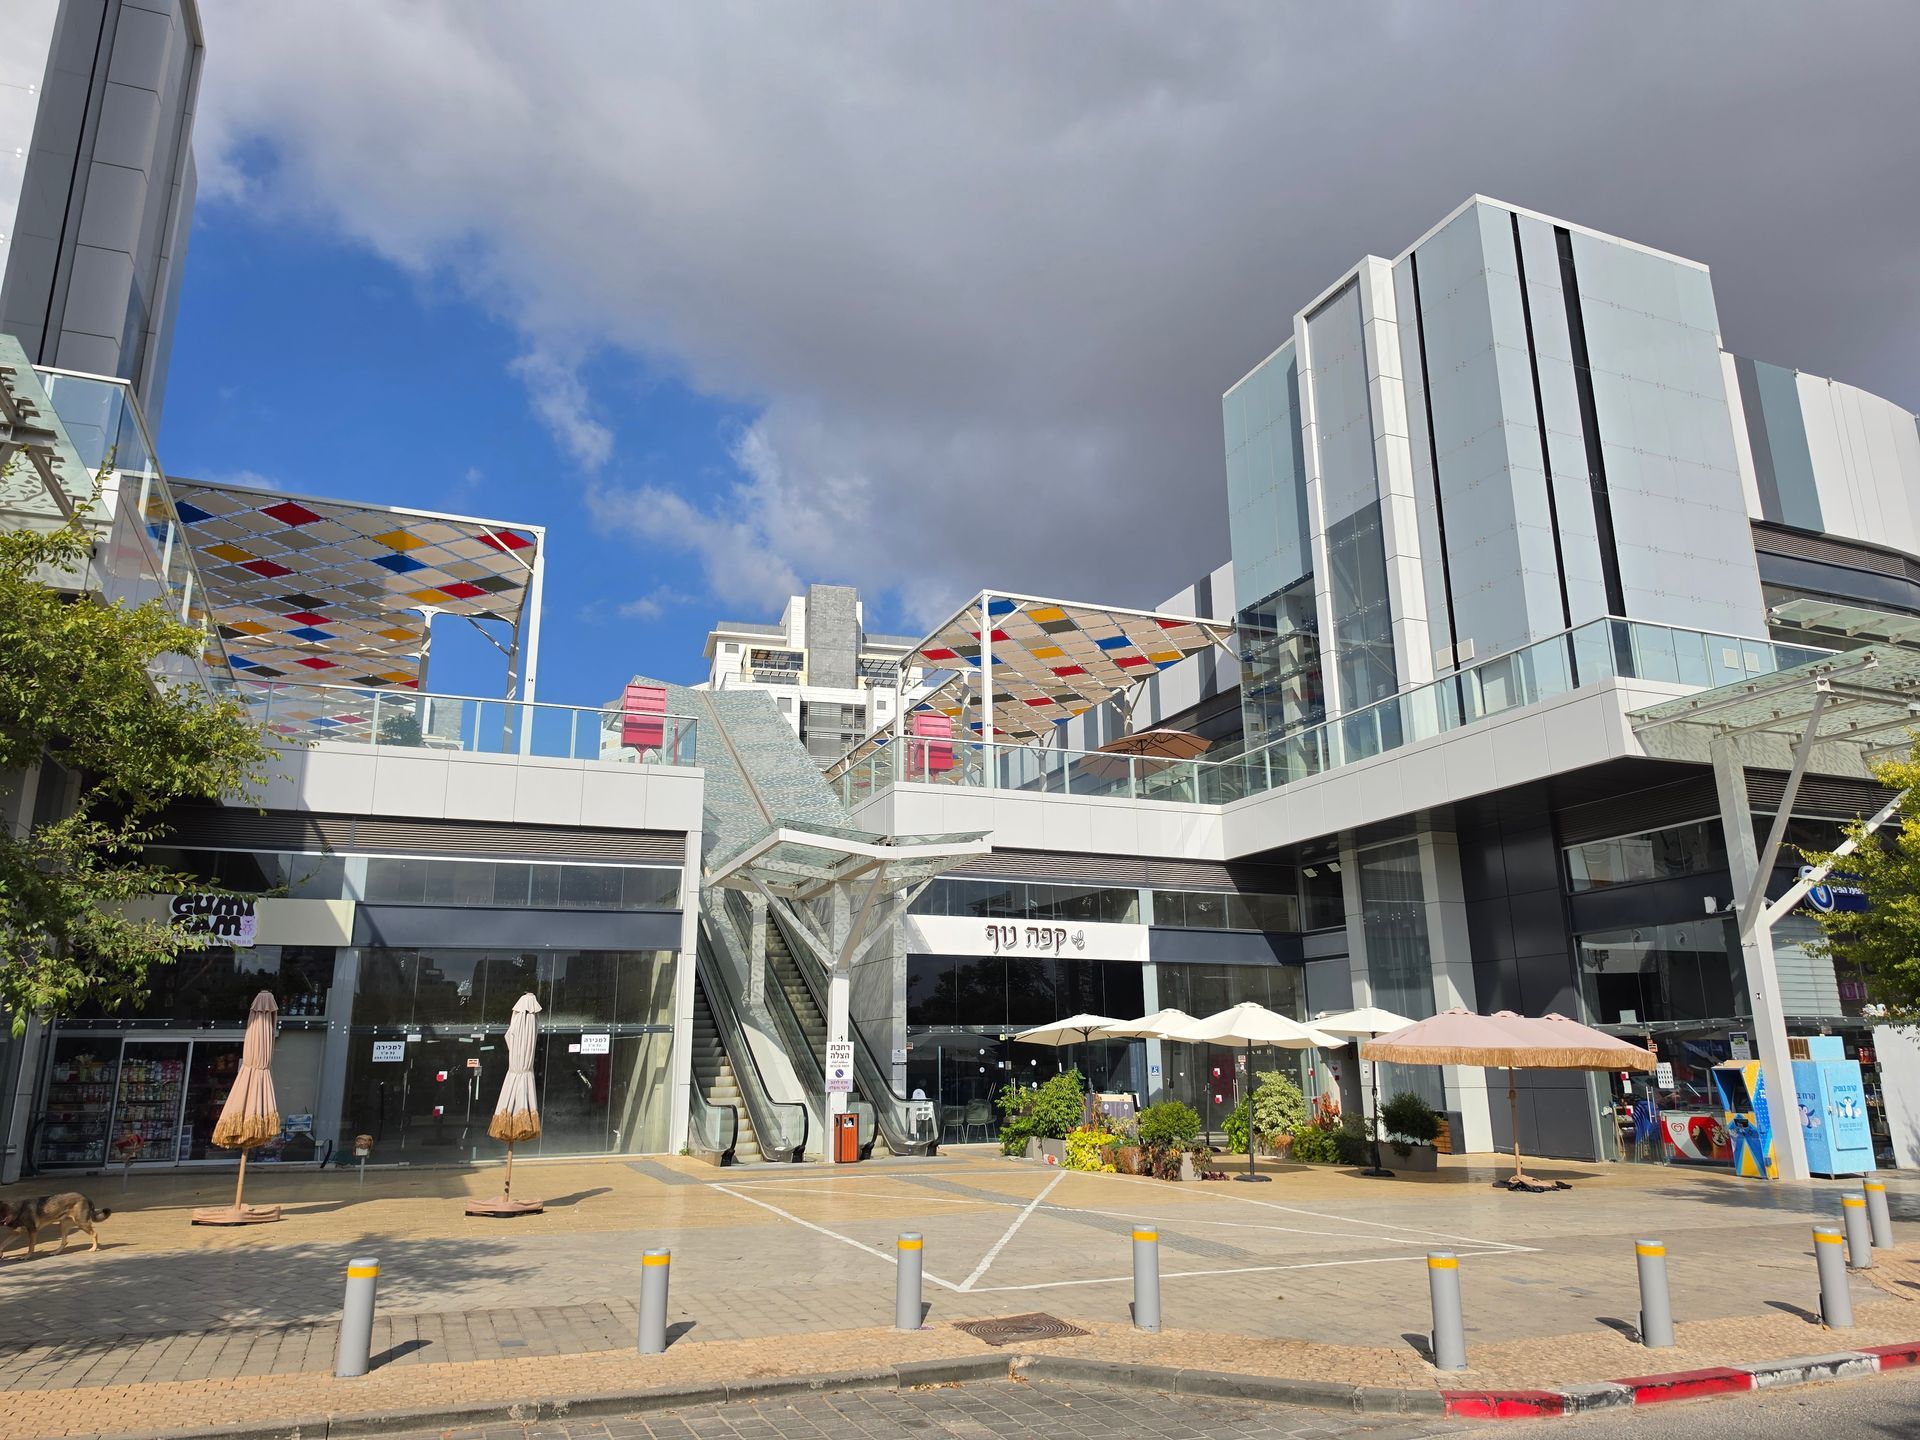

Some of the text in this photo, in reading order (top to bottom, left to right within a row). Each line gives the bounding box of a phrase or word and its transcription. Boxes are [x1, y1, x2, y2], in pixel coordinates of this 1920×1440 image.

[985, 925, 1067, 956] קפה נוף
[830, 1051, 850, 1059] הצלה
